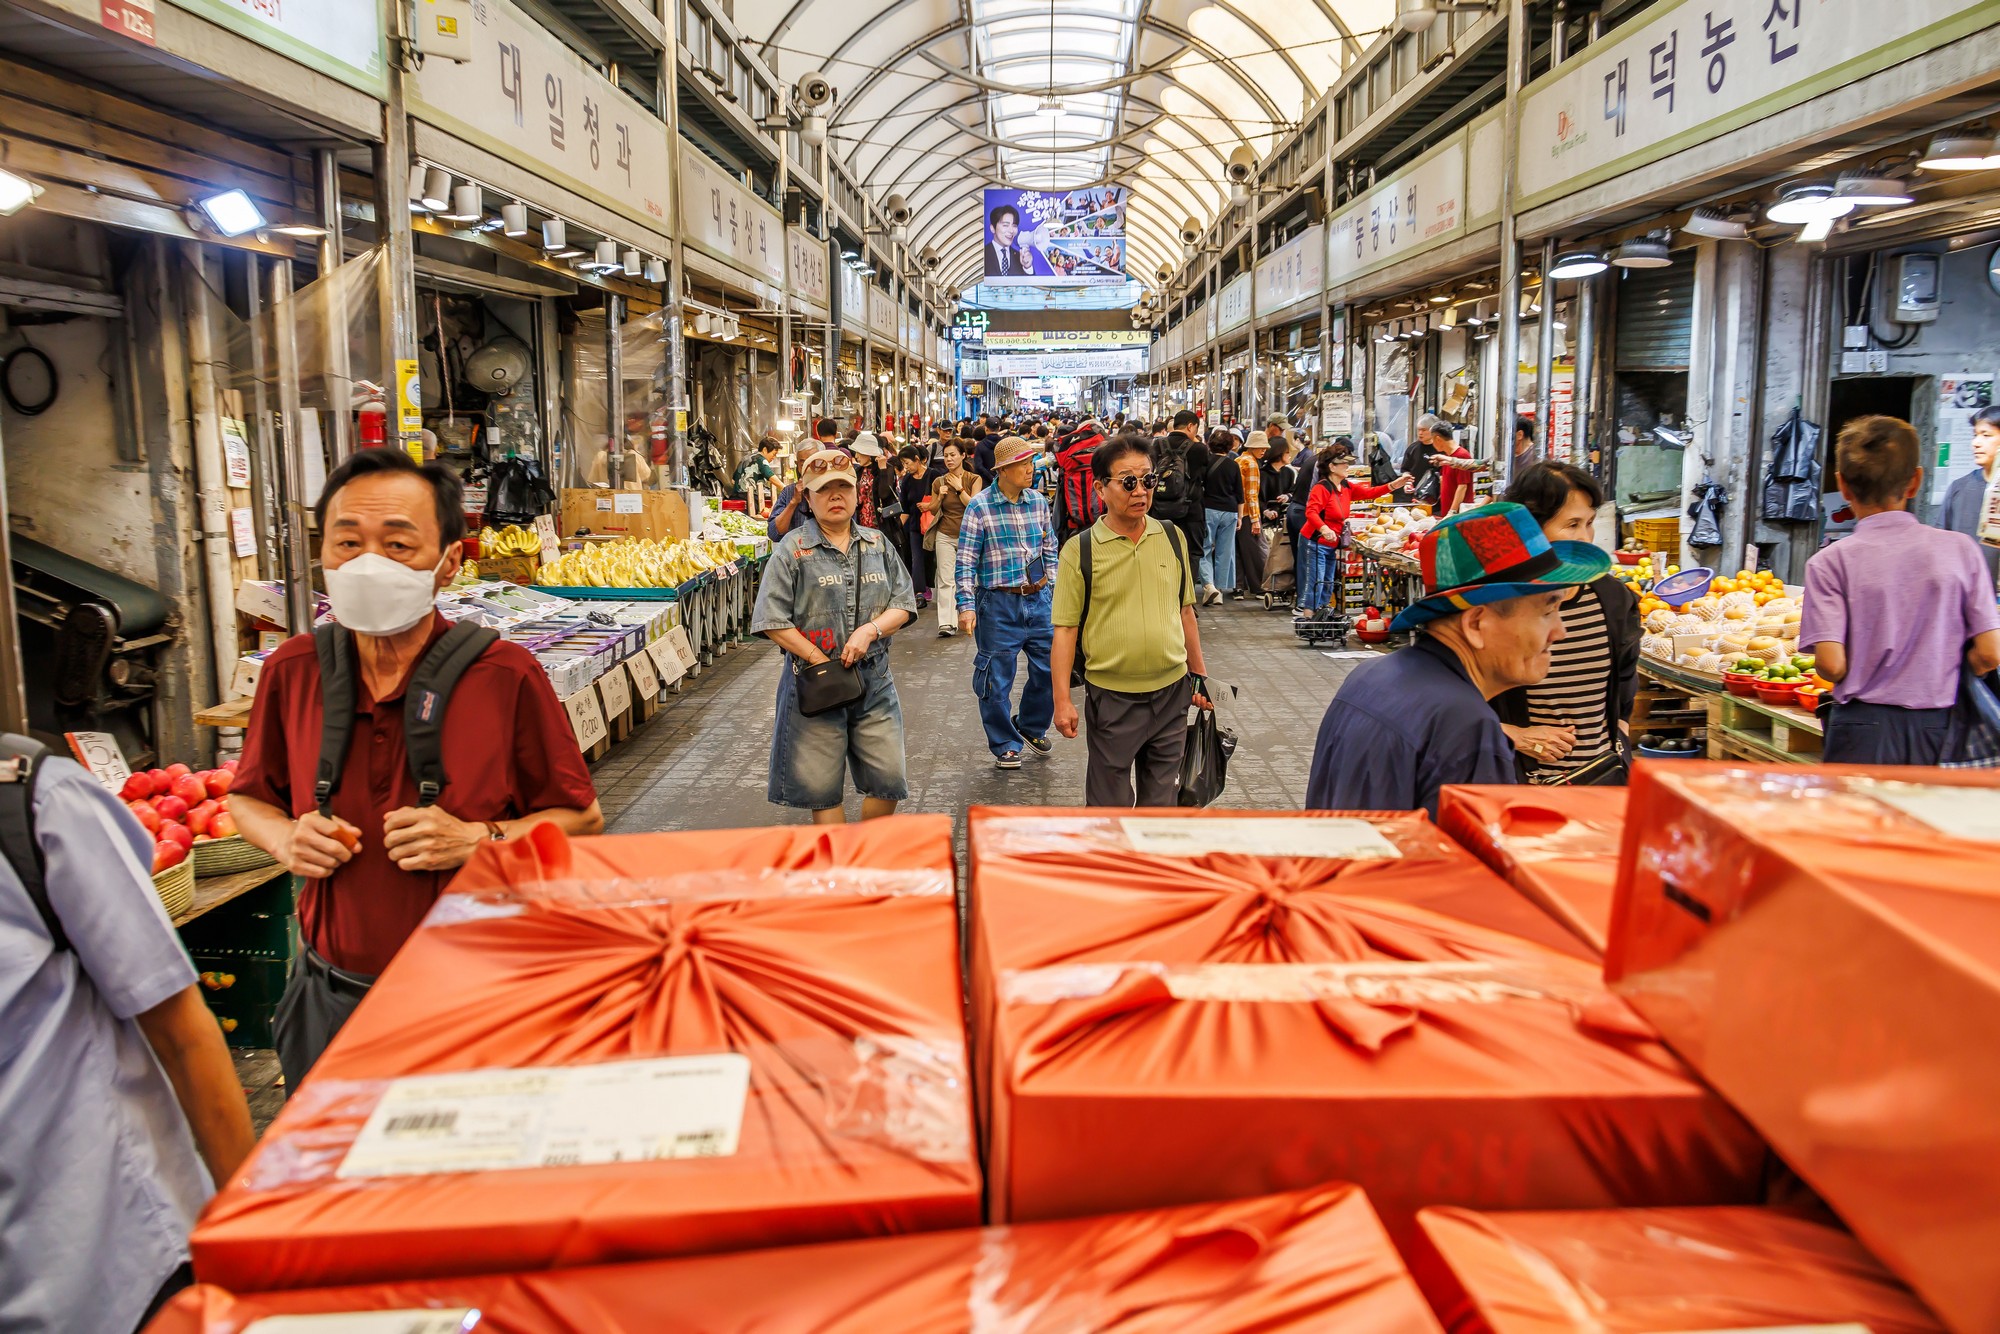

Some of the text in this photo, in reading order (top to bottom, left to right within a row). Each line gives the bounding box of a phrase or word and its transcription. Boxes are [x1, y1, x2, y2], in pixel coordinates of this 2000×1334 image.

[498, 40, 632, 189] 대일청과
[711, 188, 767, 262] 대흥상회
[1355, 184, 1418, 259] 동광상회
